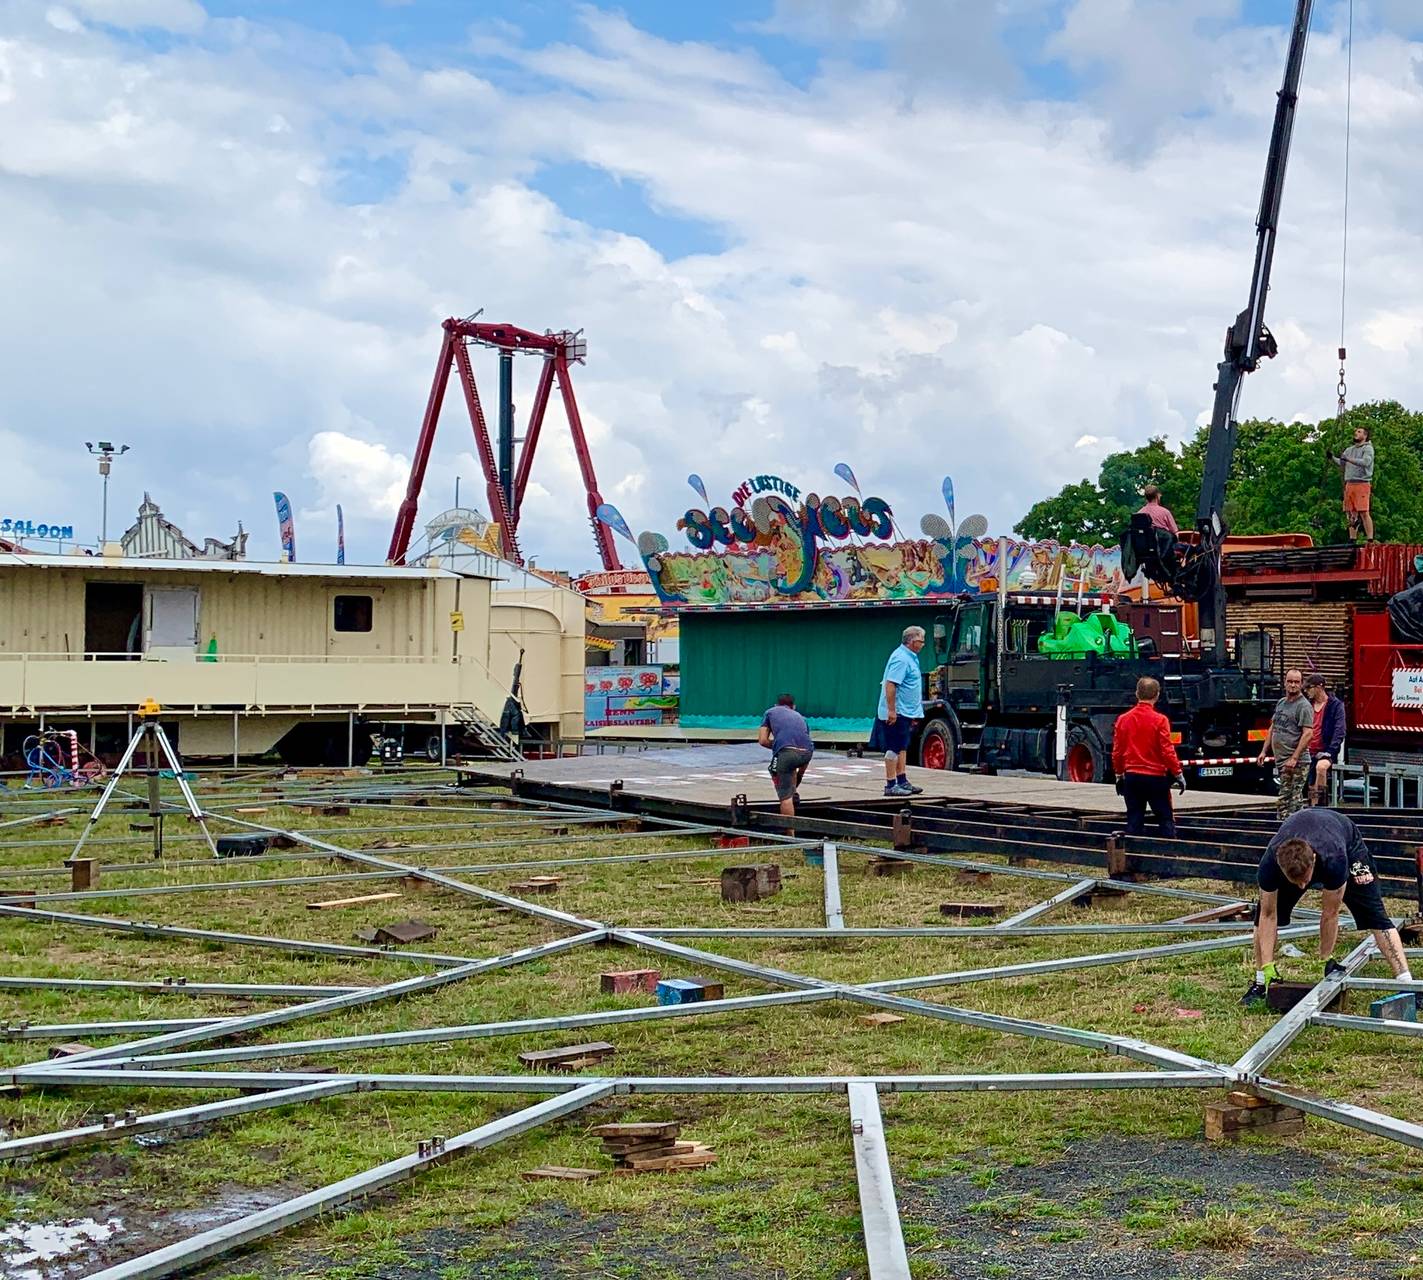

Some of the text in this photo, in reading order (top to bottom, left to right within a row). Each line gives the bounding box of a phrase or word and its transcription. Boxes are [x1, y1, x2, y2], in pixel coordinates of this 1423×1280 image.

[732, 475, 801, 508] DIE LUSTIGE
[1, 518, 73, 539] SALOON
